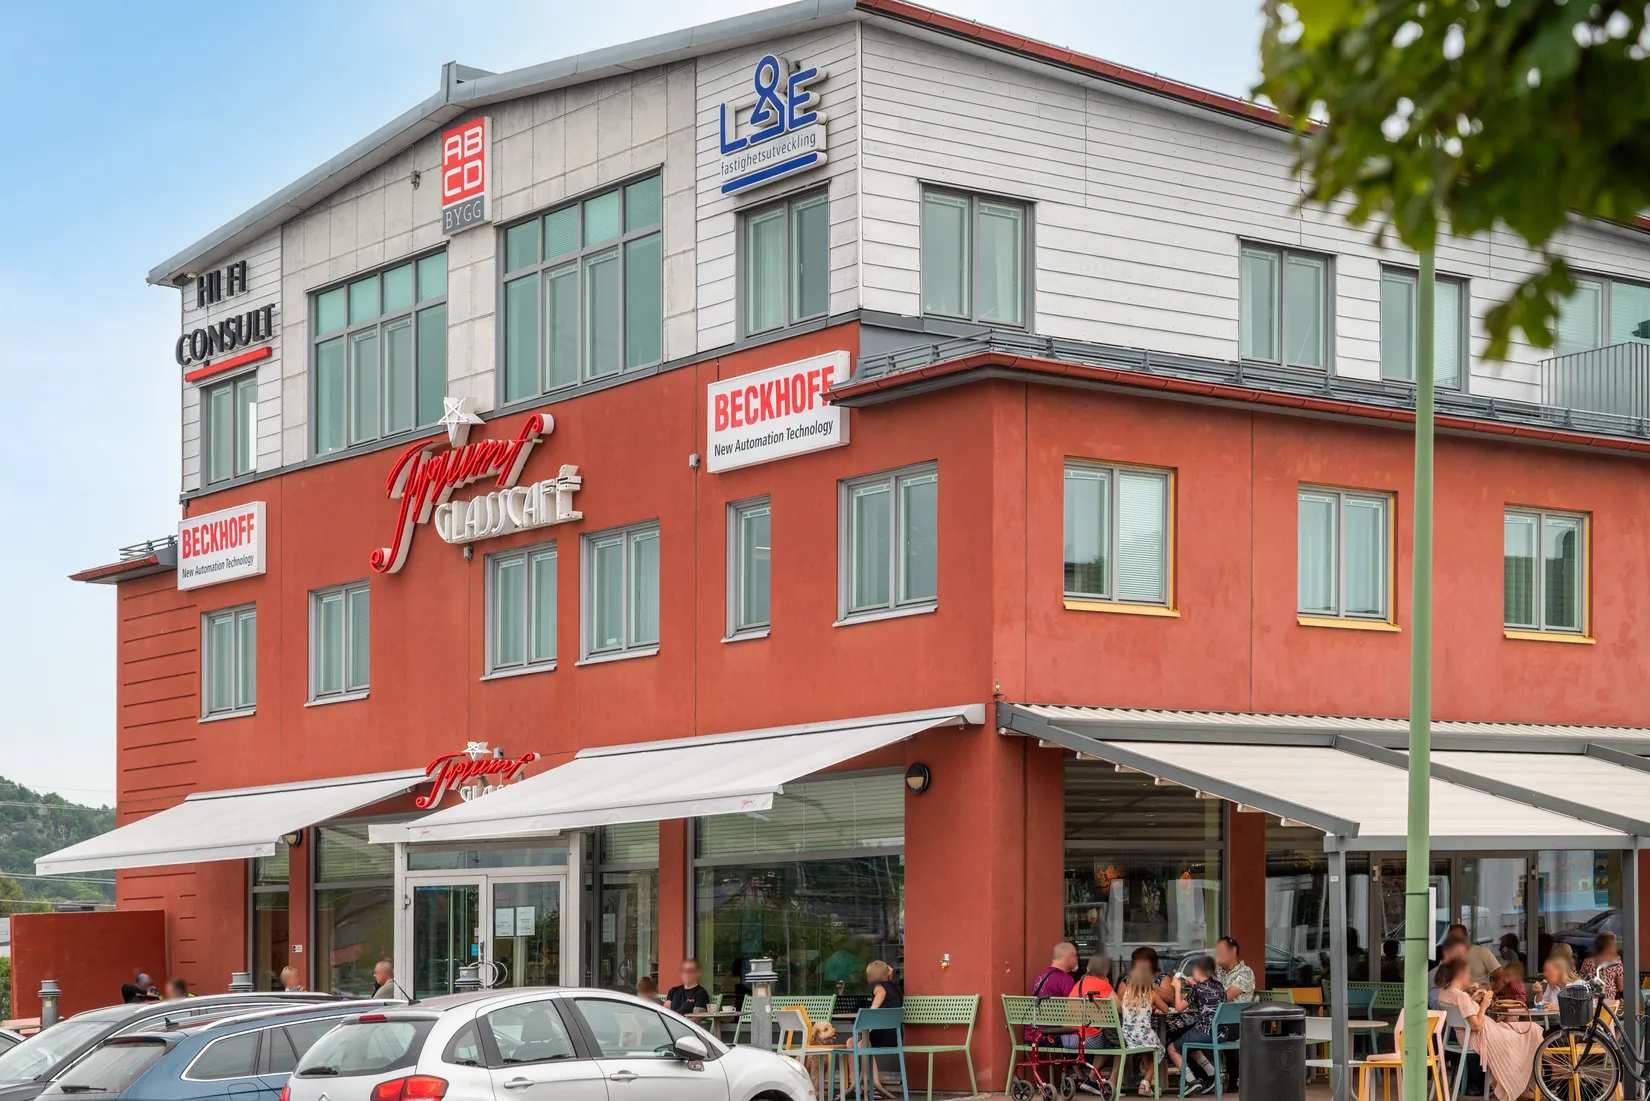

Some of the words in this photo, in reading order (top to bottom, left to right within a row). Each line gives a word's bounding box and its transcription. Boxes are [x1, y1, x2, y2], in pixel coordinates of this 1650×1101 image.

[721, 132, 816, 176] fastighetsutveckling
[446, 200, 481, 229] BYGG
[176, 303, 276, 366] CONSULT
[714, 365, 835, 432] BECKHOFF
[714, 443, 733, 457] New
[735, 431, 784, 452] Automation
[786, 419, 833, 440] Technology
[182, 512, 254, 559] BECKHOFF
[182, 567, 194, 578] New
[195, 560, 225, 575] Automation
[226, 553, 254, 568] Technology
